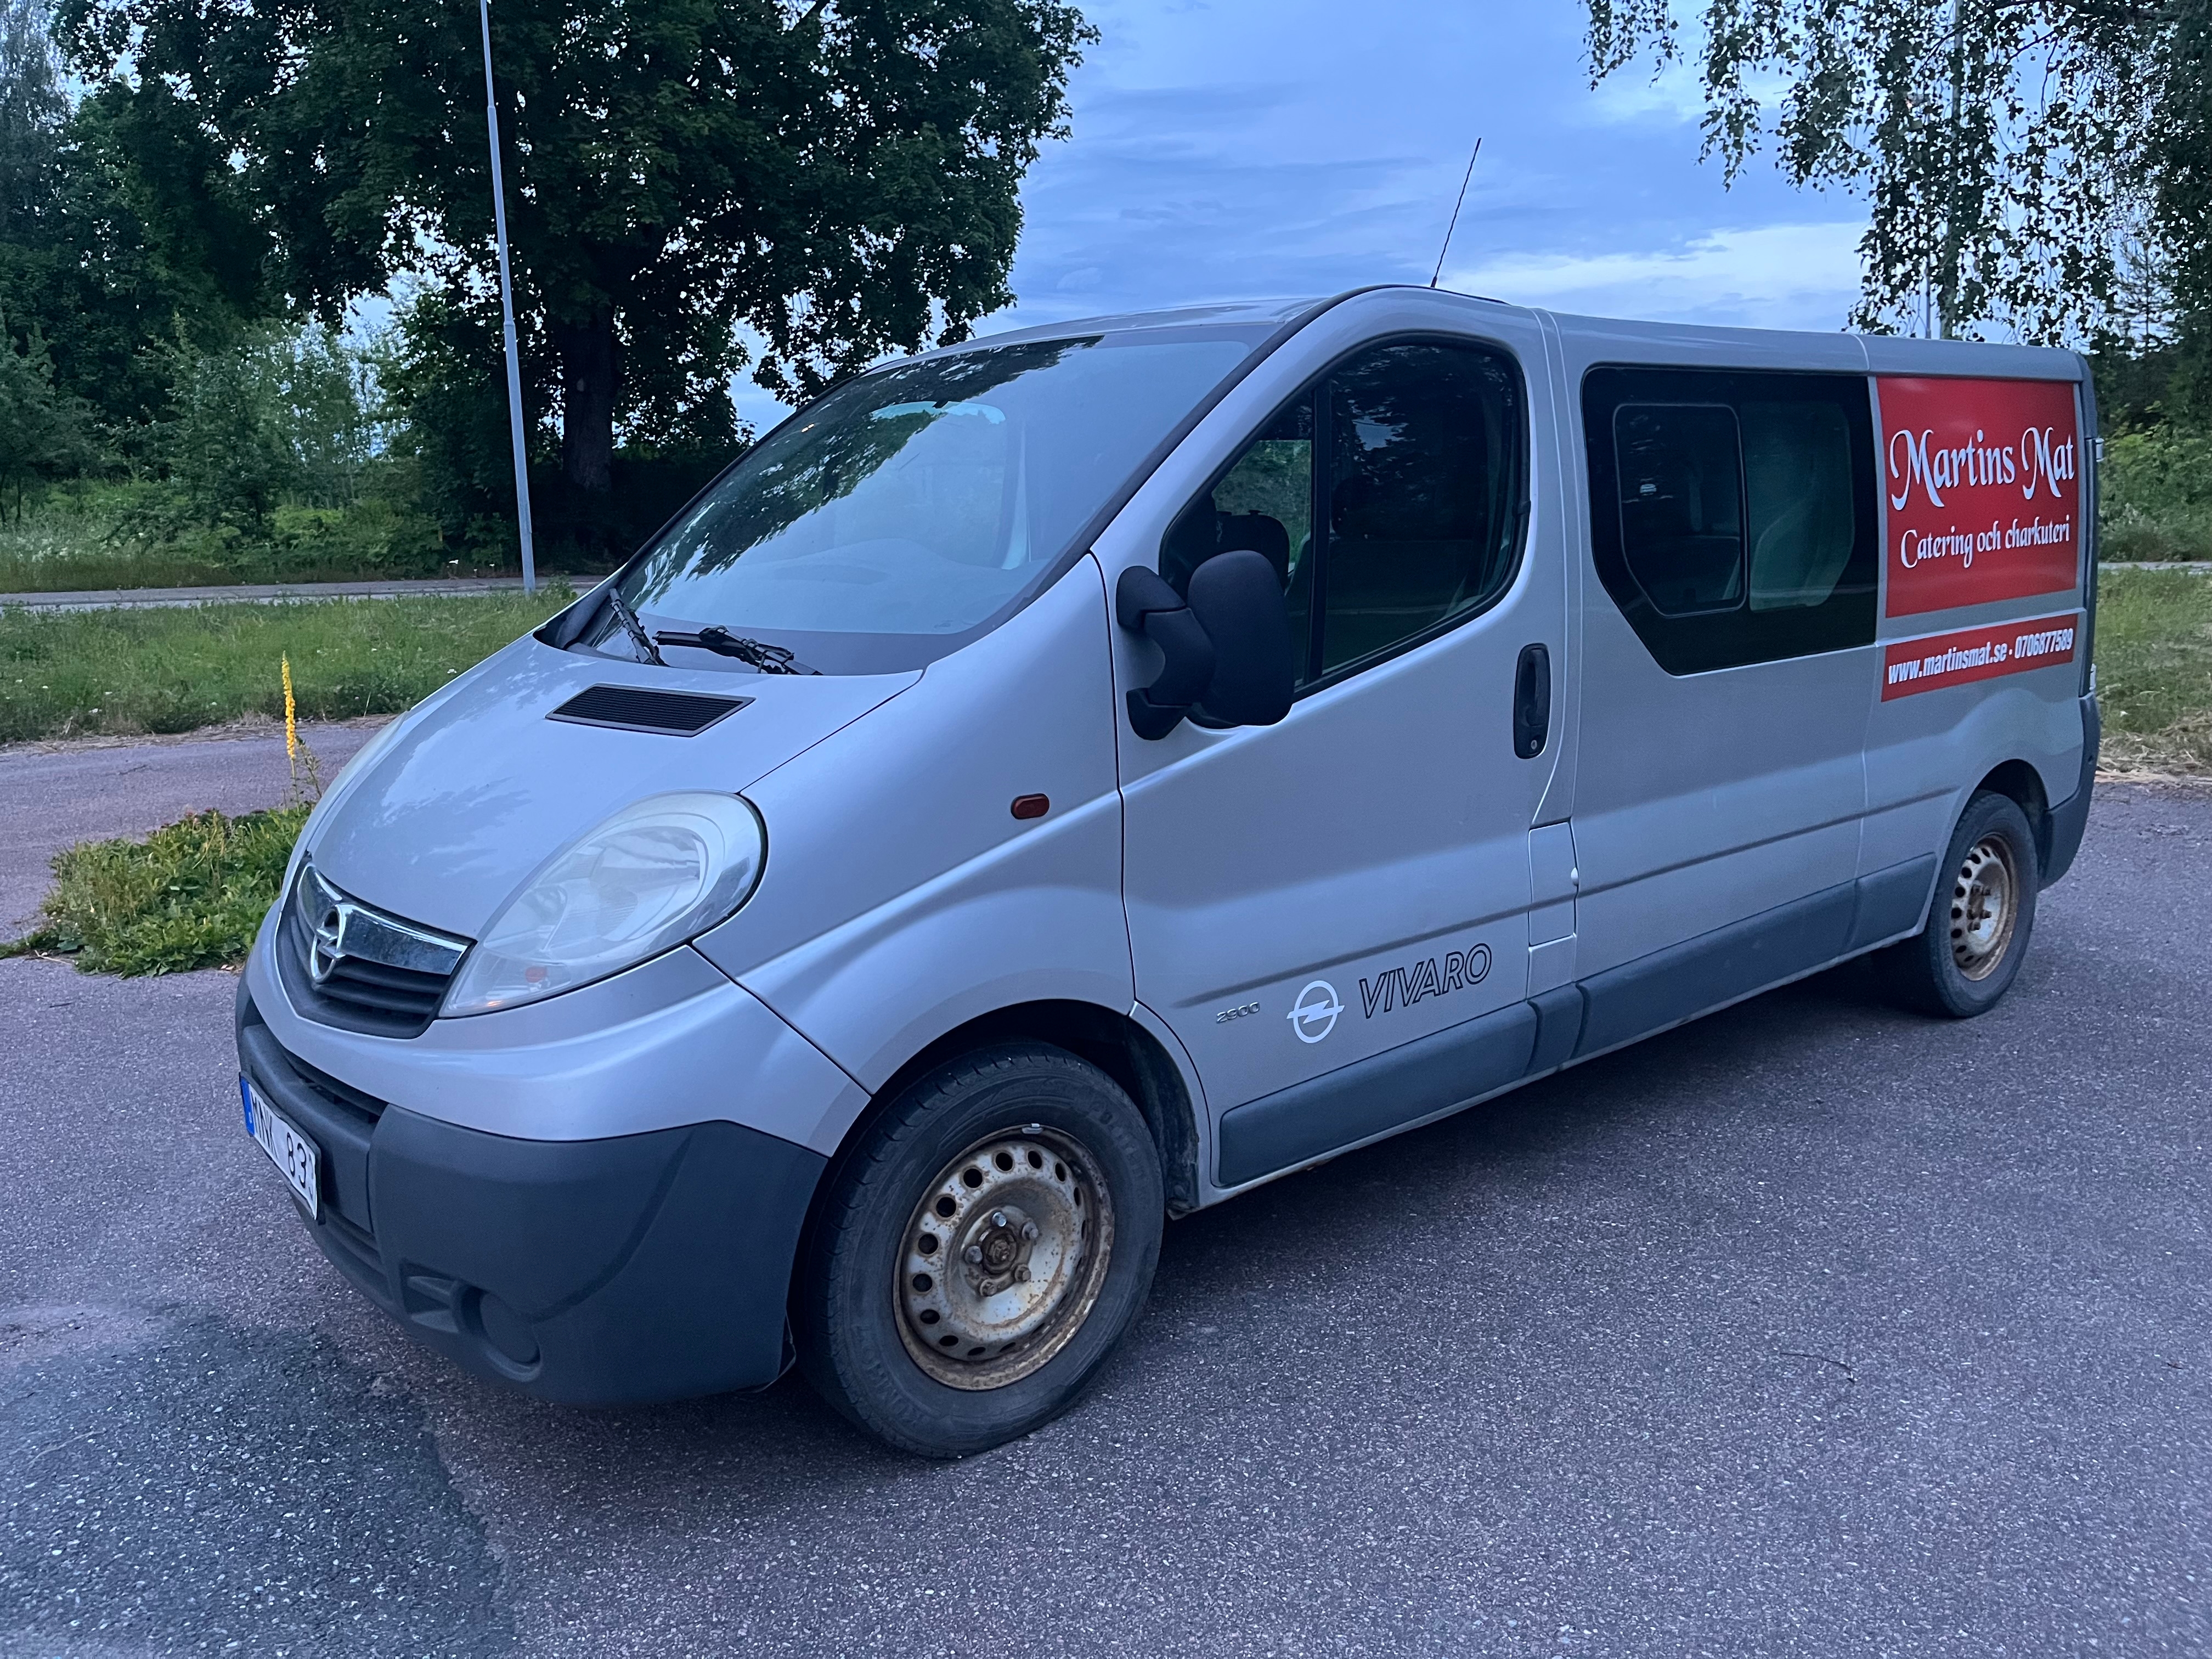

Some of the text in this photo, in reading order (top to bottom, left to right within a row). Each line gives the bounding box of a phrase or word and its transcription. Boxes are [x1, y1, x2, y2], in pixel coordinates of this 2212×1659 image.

[1889, 427, 2074, 510] Martins Mat
[1900, 514, 2070, 568] Catering och charkuteri
[1888, 642, 2007, 684] www.martinsmat.se
[2015, 628, 2073, 658] 0706877589
[1359, 943, 1492, 1019] VIVARO
[1216, 1002, 1260, 1024] 2900
